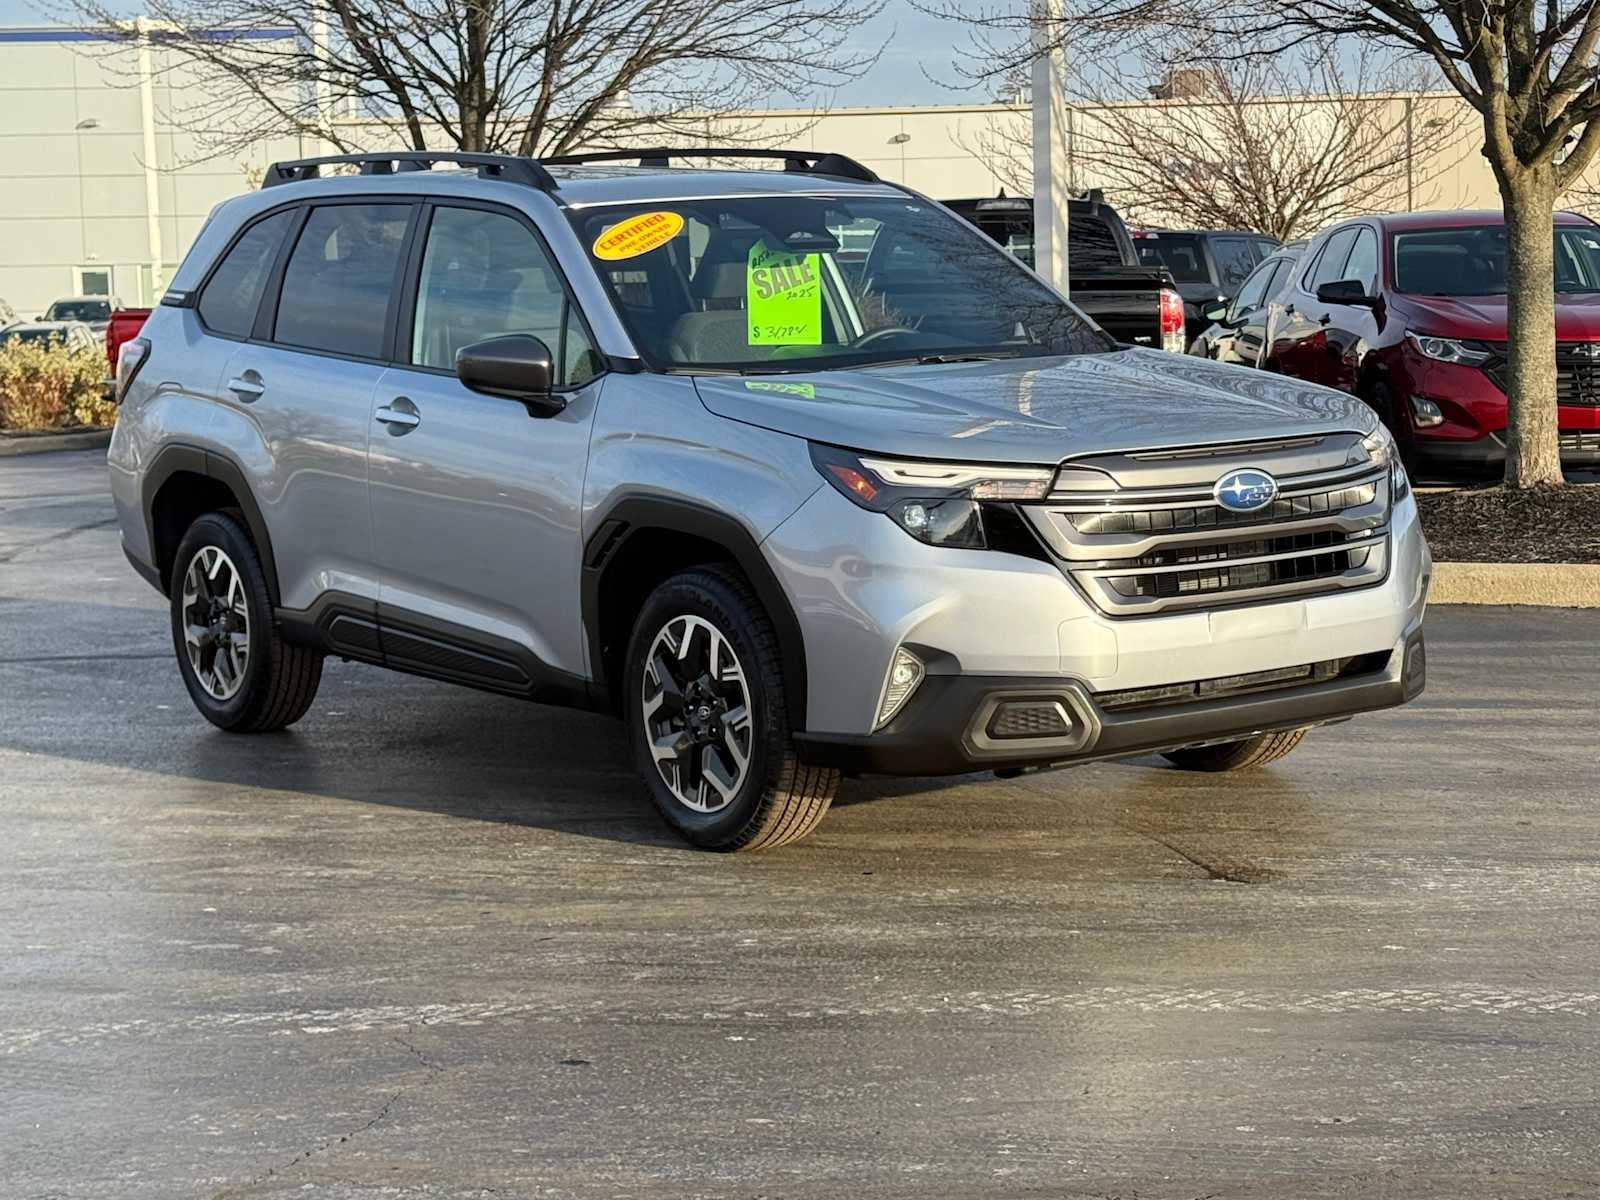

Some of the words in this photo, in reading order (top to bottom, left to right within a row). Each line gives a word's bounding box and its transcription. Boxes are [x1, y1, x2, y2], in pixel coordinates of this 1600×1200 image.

[599, 213, 666, 250] CERTIFIED
[751, 263, 816, 300] SALE
[786, 285, 817, 301] 2025
